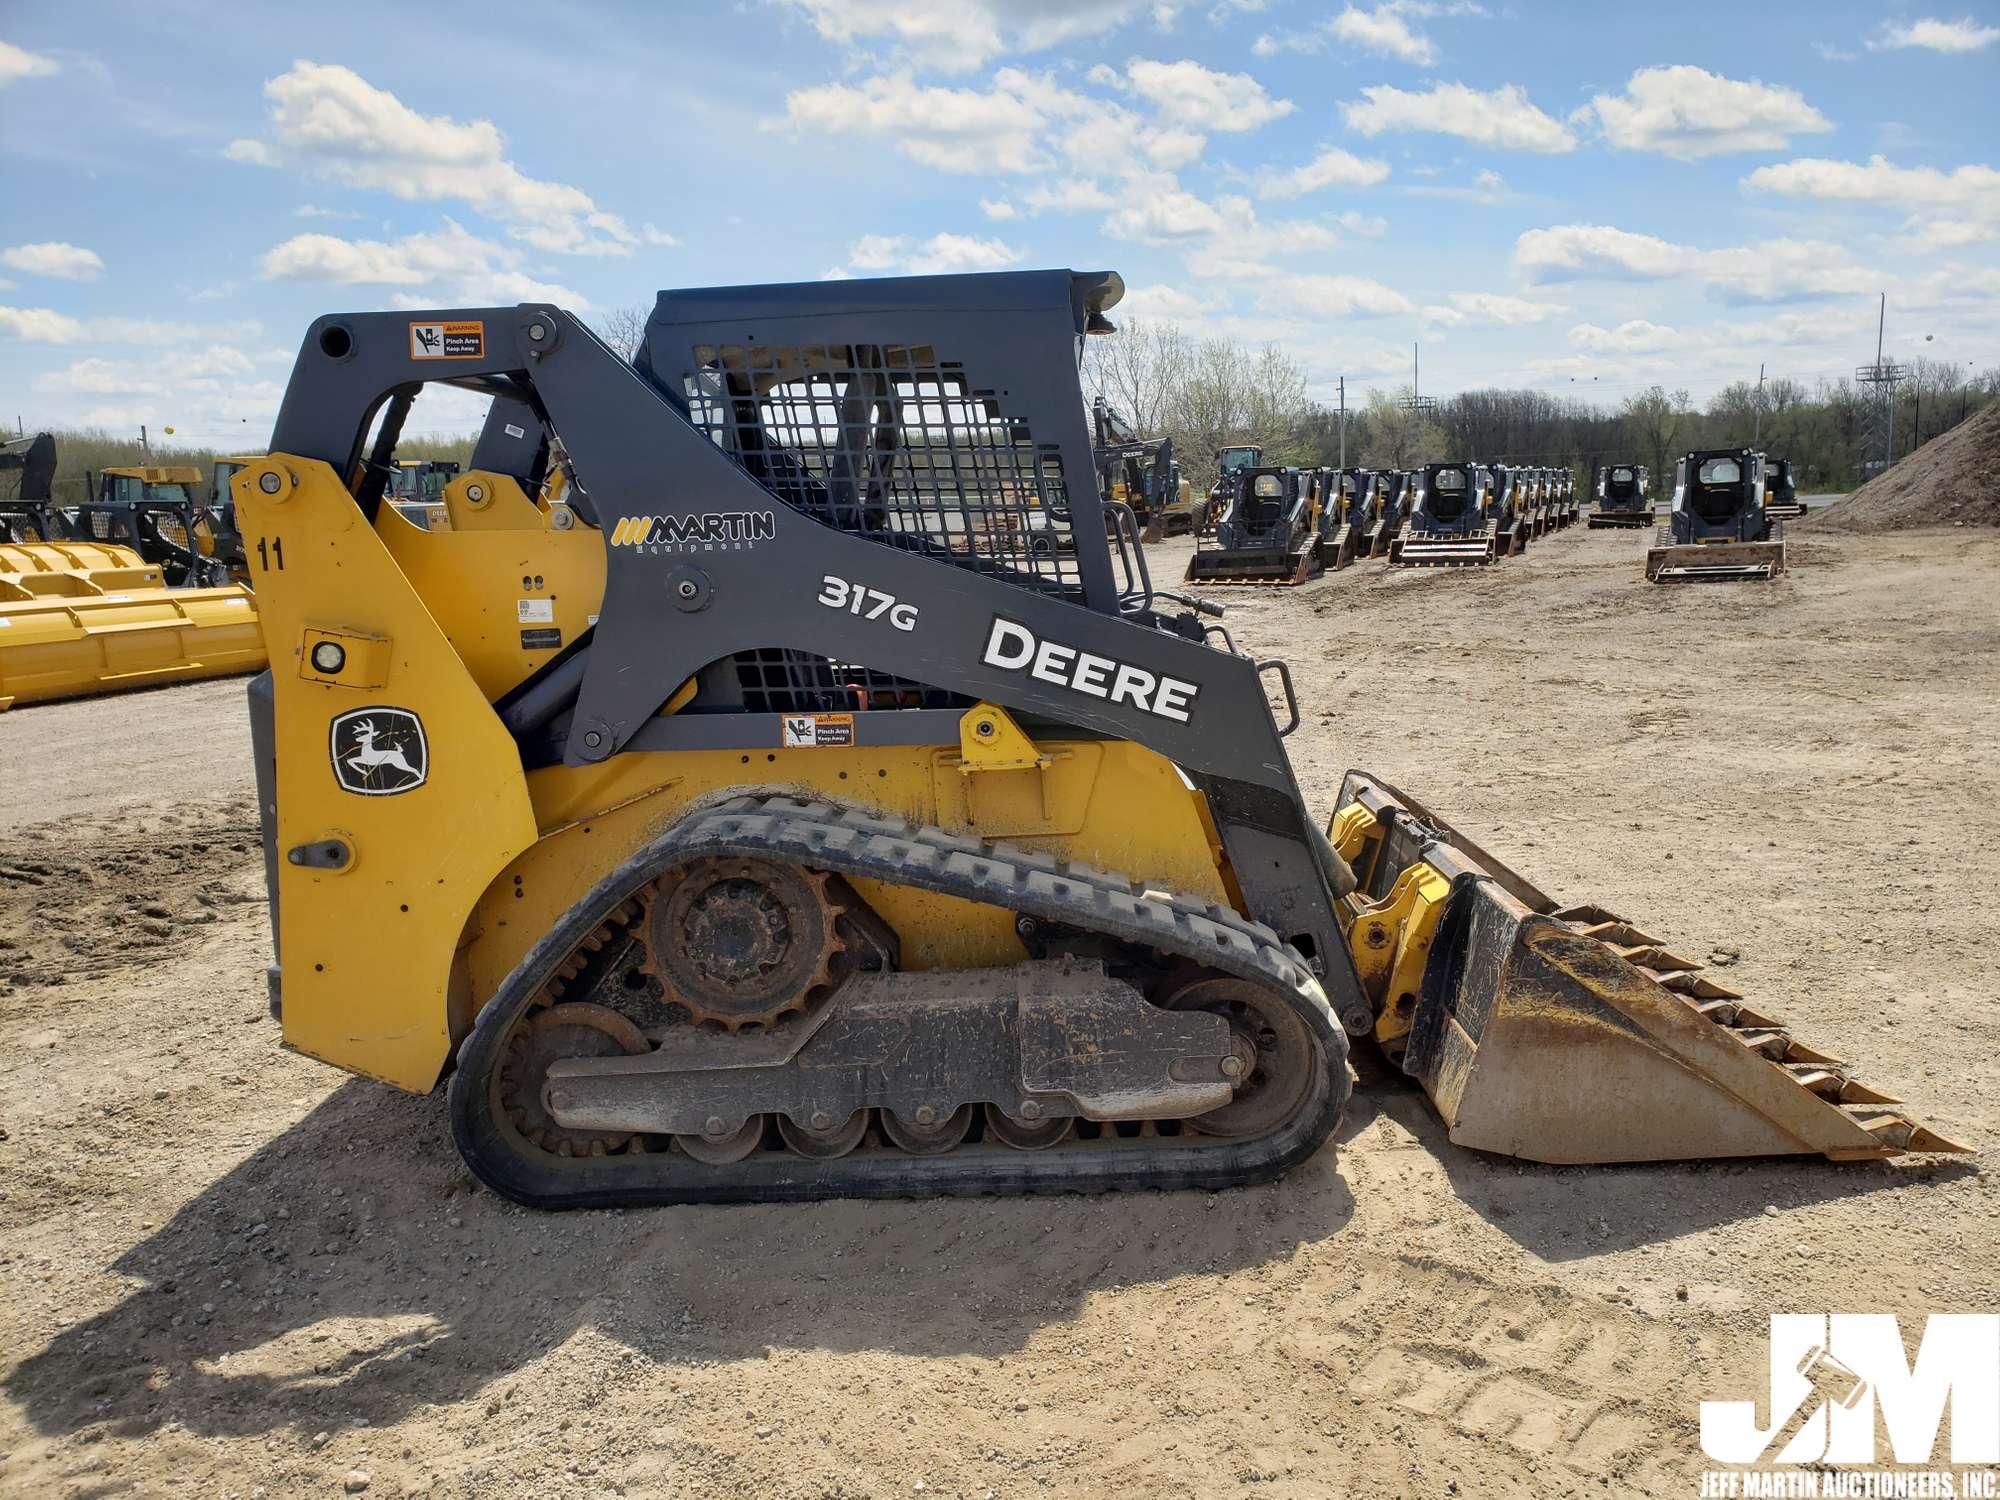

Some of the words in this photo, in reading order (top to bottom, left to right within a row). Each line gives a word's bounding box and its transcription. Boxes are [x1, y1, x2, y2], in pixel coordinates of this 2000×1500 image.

[645, 511, 775, 544] MARTIN
[257, 536, 284, 571] 11
[636, 542, 755, 555] Equipment
[818, 575, 919, 632] 317G
[984, 618, 1198, 722] DEERE
